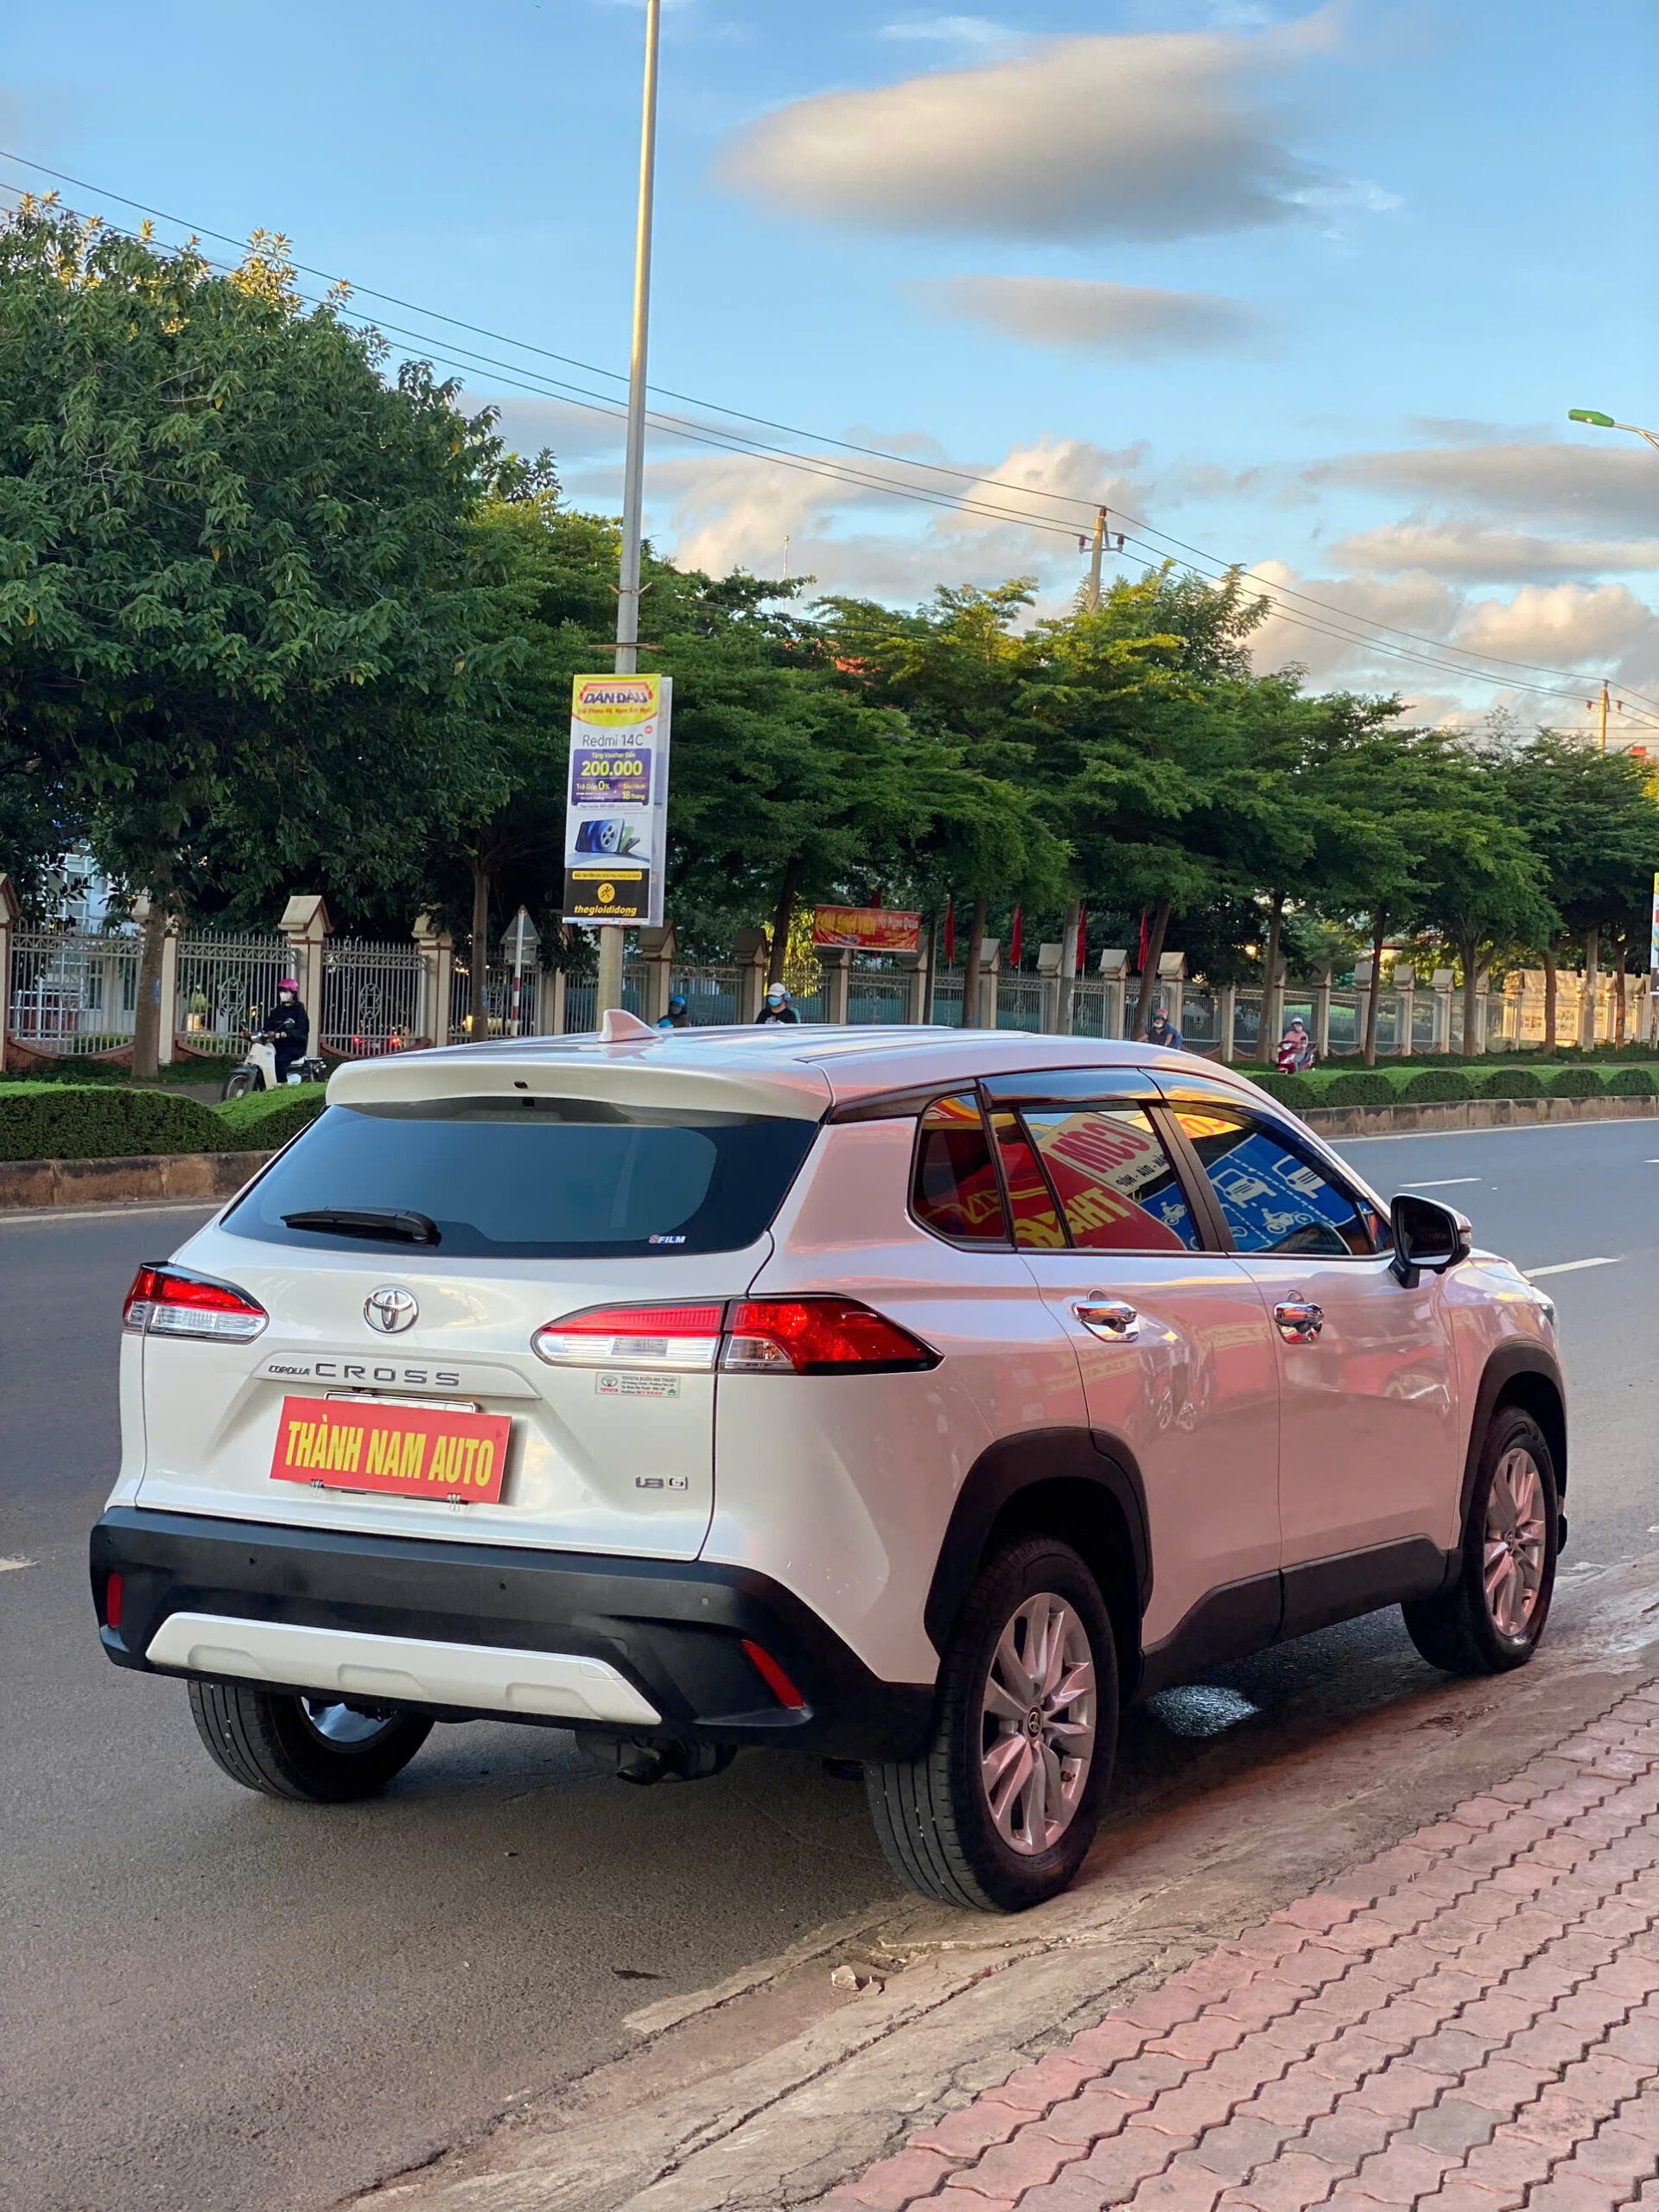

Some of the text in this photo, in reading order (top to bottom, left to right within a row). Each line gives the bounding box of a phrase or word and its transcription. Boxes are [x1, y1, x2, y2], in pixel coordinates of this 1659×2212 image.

[582, 734, 644, 747] Redmi 14C
[581, 760, 643, 776] 200.000
[574, 905, 637, 916] thegioididong
[269, 1363, 460, 1386] COROLLA CROSS
[285, 1414, 494, 1487] THÀNH NAM AUTO
